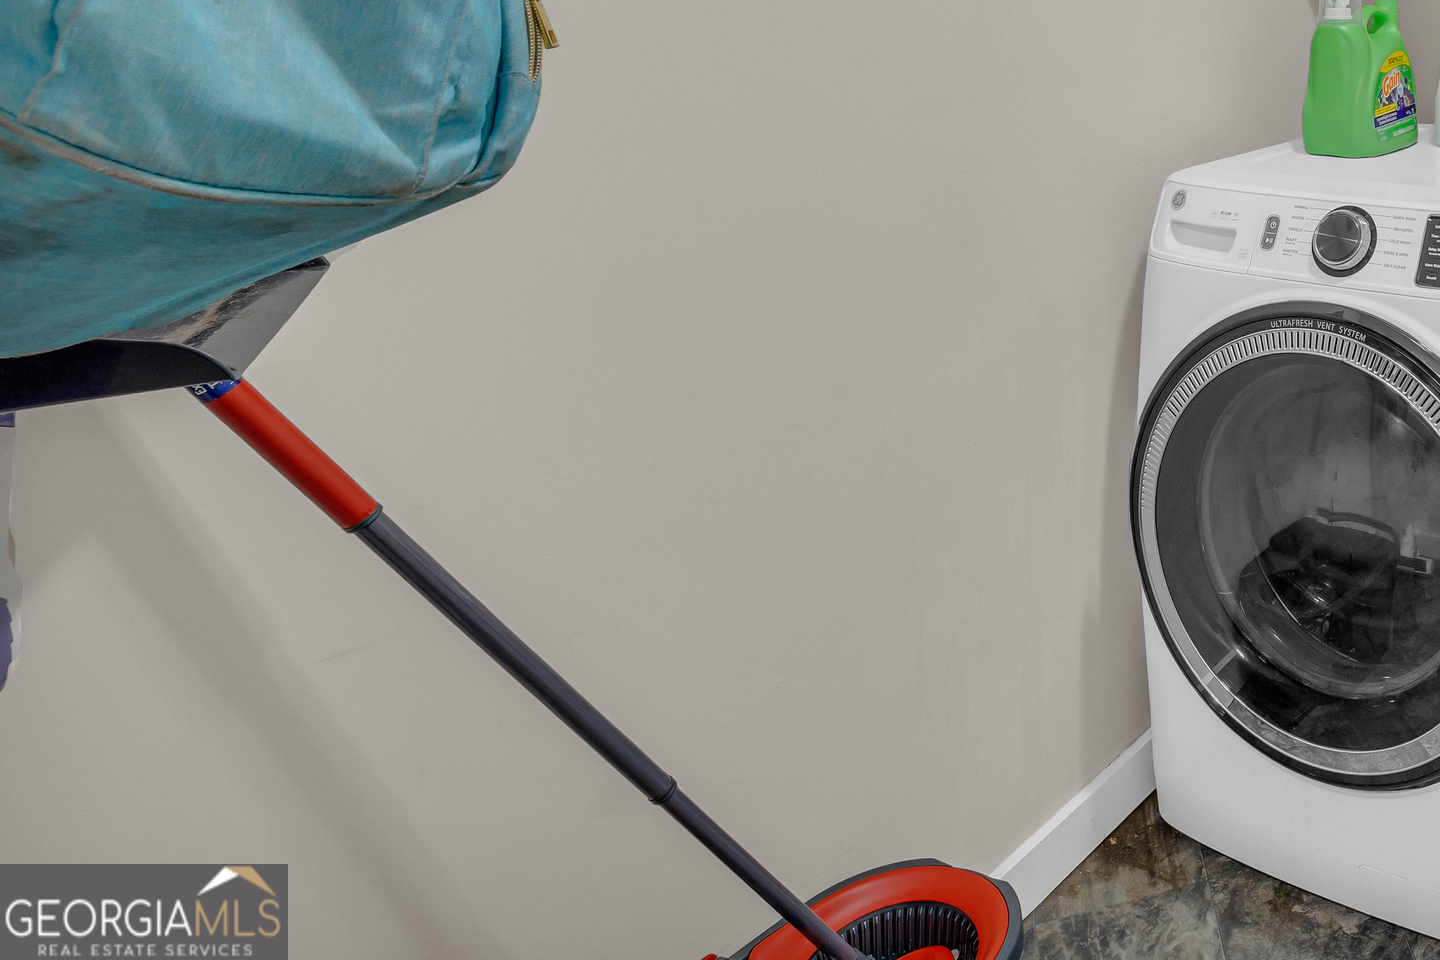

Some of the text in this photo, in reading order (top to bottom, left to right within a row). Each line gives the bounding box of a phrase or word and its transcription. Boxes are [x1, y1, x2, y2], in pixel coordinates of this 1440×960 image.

[1383, 70, 1401, 97] Gain
[1270, 319, 1367, 342] ULTRAFRESH VENT SYSTEM
